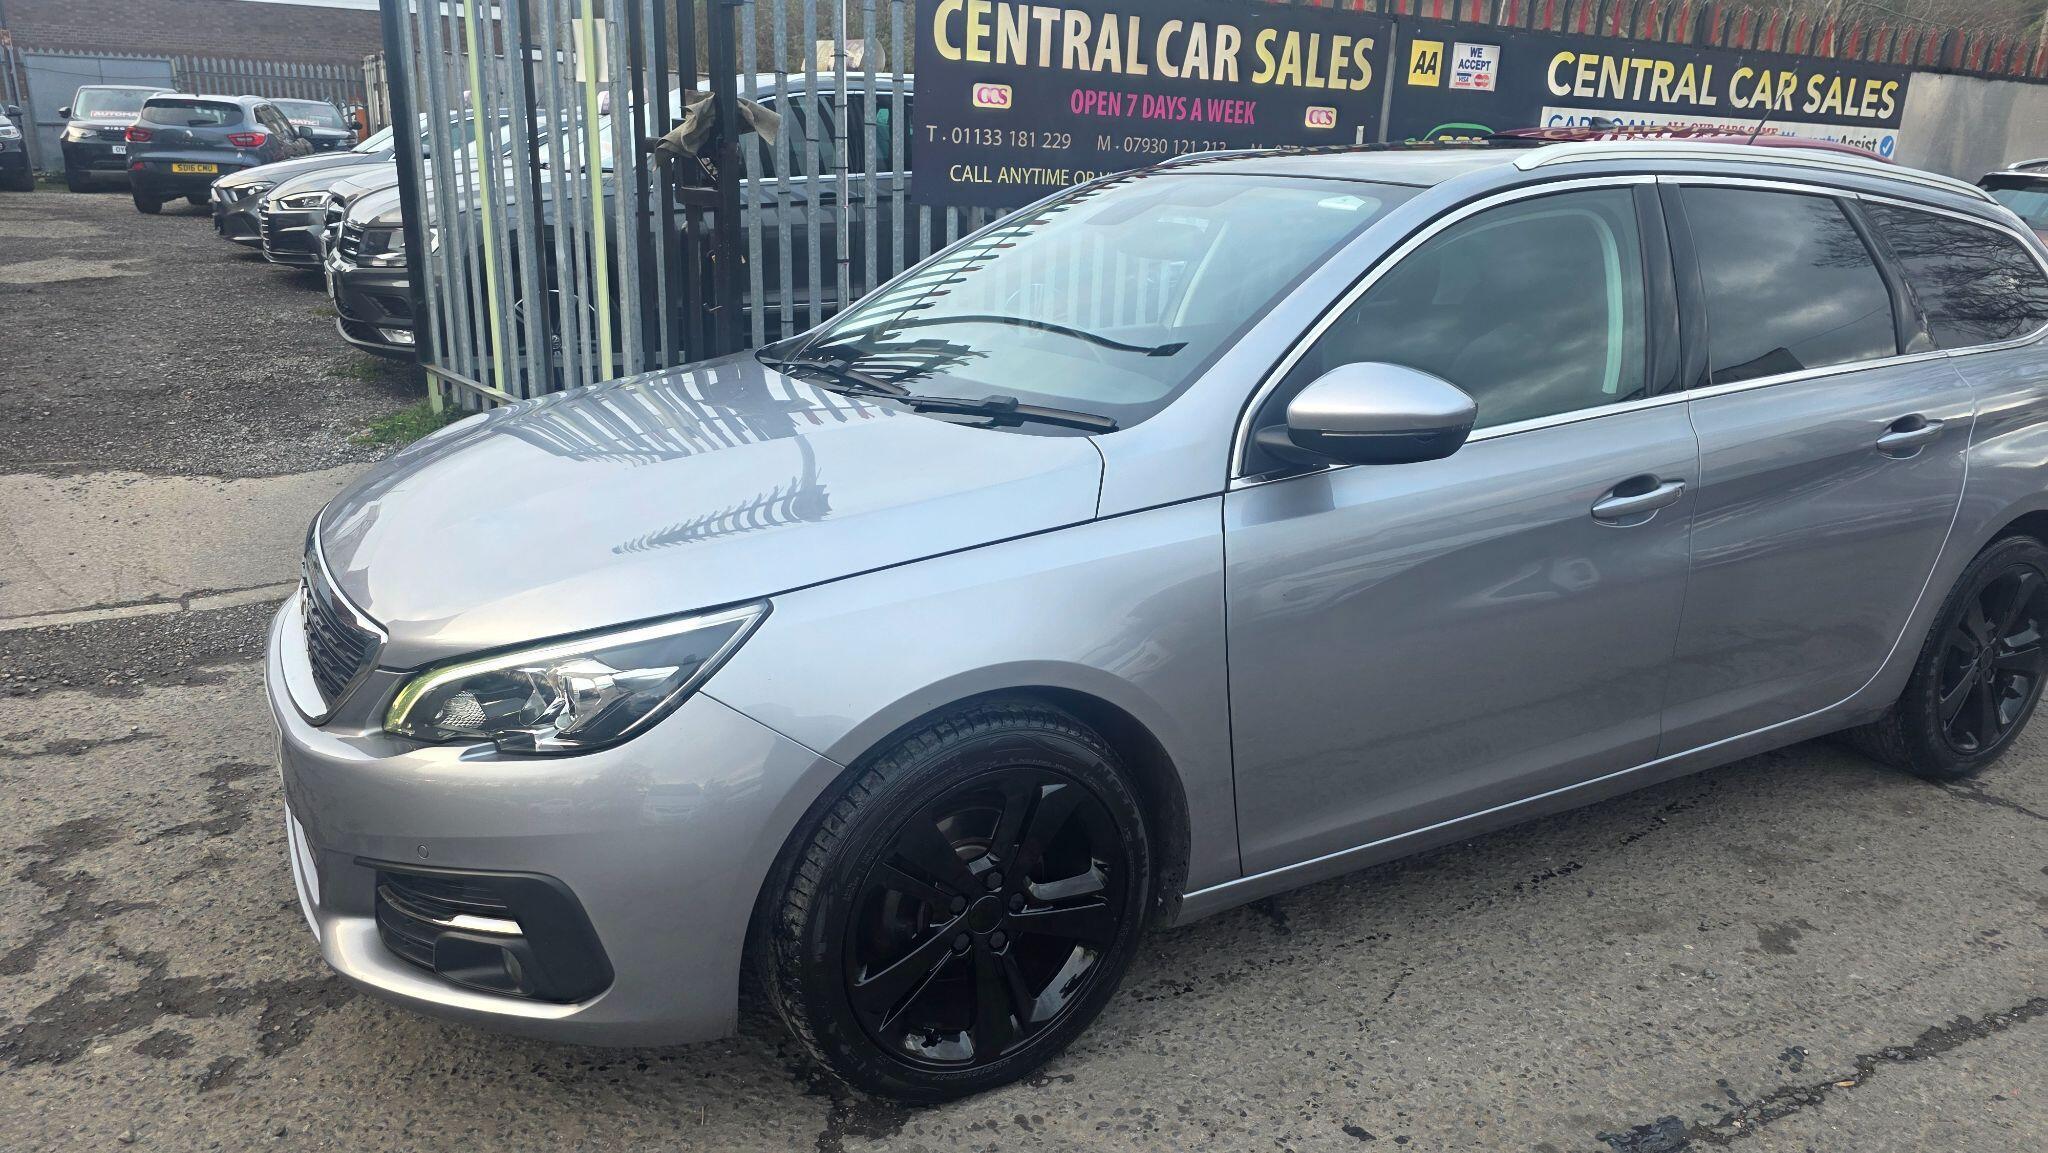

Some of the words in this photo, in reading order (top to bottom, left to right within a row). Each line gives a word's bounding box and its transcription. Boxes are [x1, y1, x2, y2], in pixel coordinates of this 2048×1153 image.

[934, 0, 1149, 76] CENTRAL
[1156, 19, 1242, 82] CAR
[1252, 28, 1375, 91] SALES
[1470, 46, 1484, 58] WE
[1412, 50, 1439, 75] AA
[1458, 58, 1492, 71] ACCEPT
[1547, 51, 1718, 106] CENTRAL
[1729, 67, 1798, 111] CAR
[1803, 73, 1899, 119] SALES
[1070, 88, 1122, 117] OPEN
[1126, 93, 1139, 118] 7
[1142, 94, 1187, 121] DAYS
[1190, 97, 1203, 122] A
[1207, 98, 1257, 125] WEEK
[951, 127, 1002, 146] 01133
[1009, 130, 1035, 148] 181
[1042, 132, 1072, 150] 229
[1123, 136, 1168, 153] 07930
[1173, 139, 1196, 154] 121
[950, 164, 993, 183] CALL
[997, 167, 1070, 186] ANYTIME
